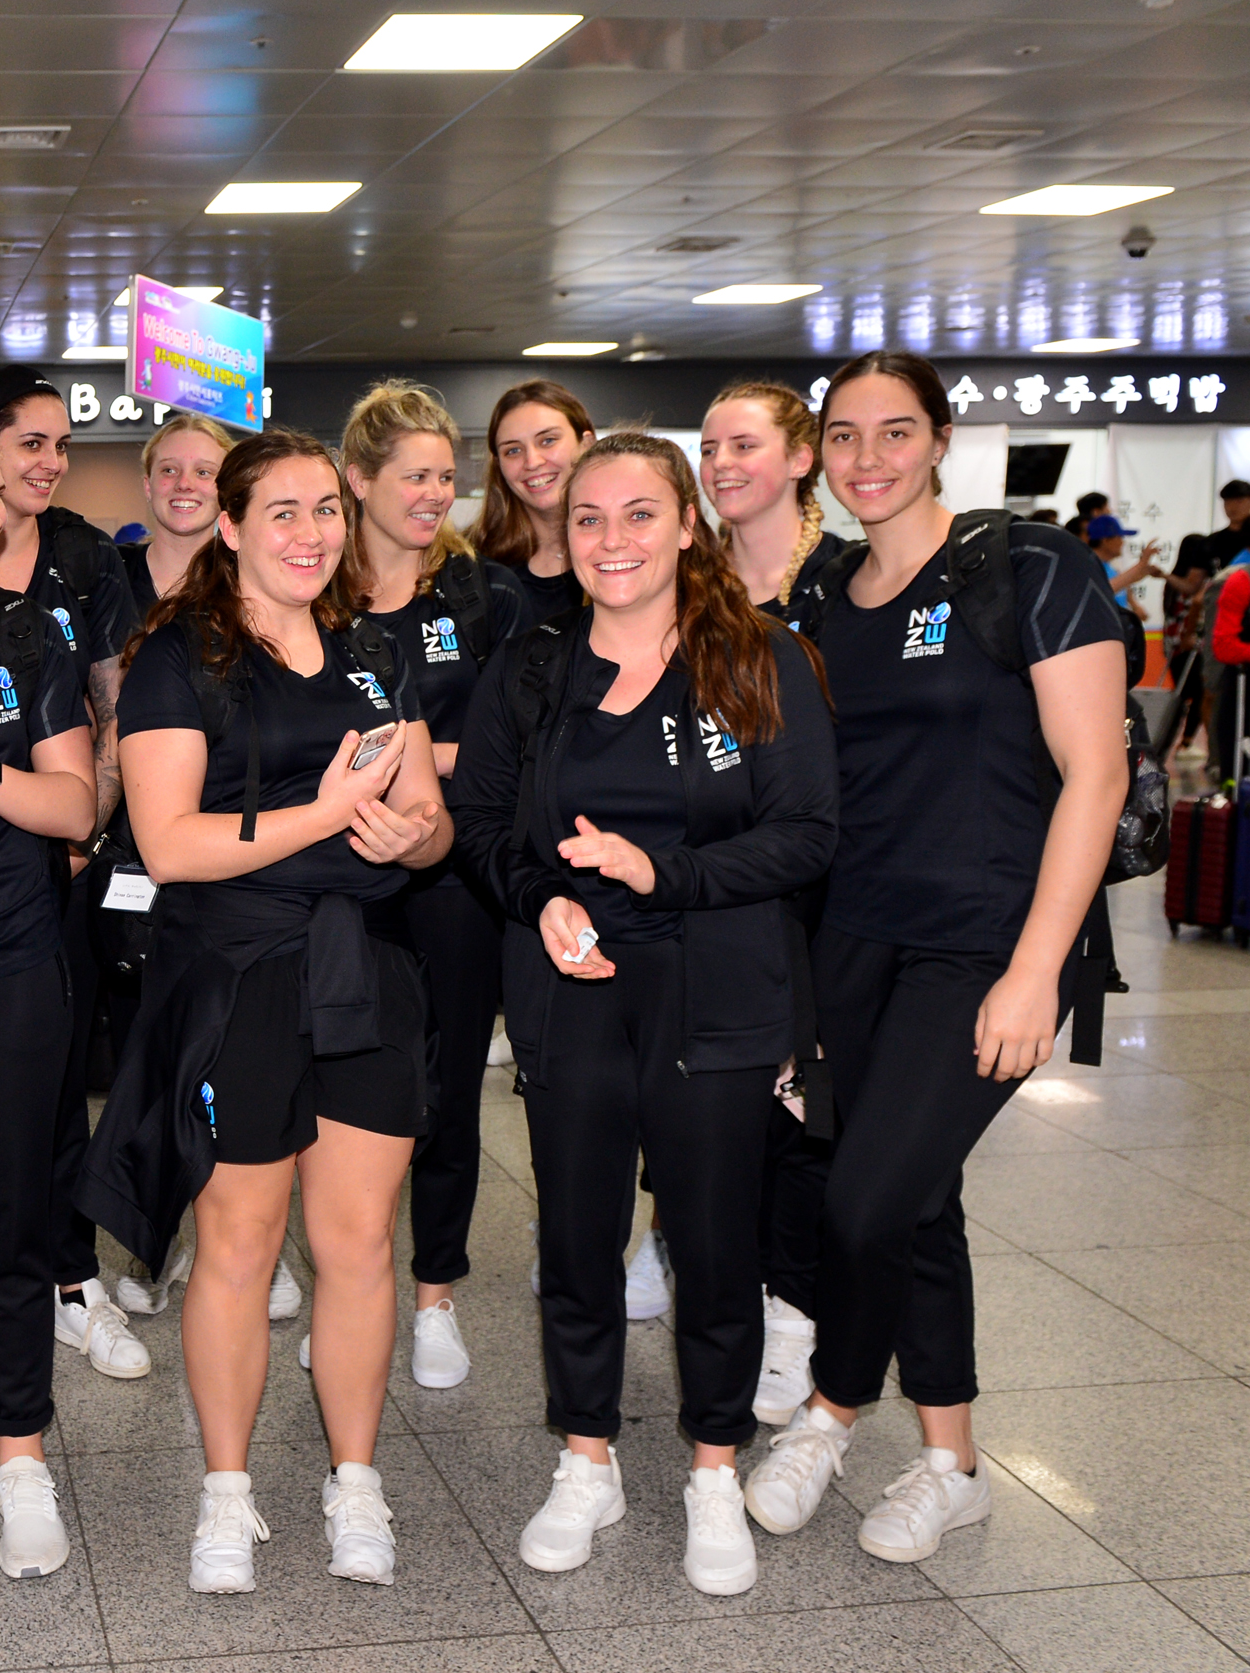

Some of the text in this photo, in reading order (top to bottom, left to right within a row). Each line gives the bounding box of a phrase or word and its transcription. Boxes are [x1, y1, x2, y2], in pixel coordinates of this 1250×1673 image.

[143, 313, 257, 374] Welcome To Gwang-Ju
[4, 598, 24, 612] 2XU
[916, 643, 944, 652] ZEALAND
[902, 648, 944, 660] WATER POLO
[9, 713, 21, 721] POLO
